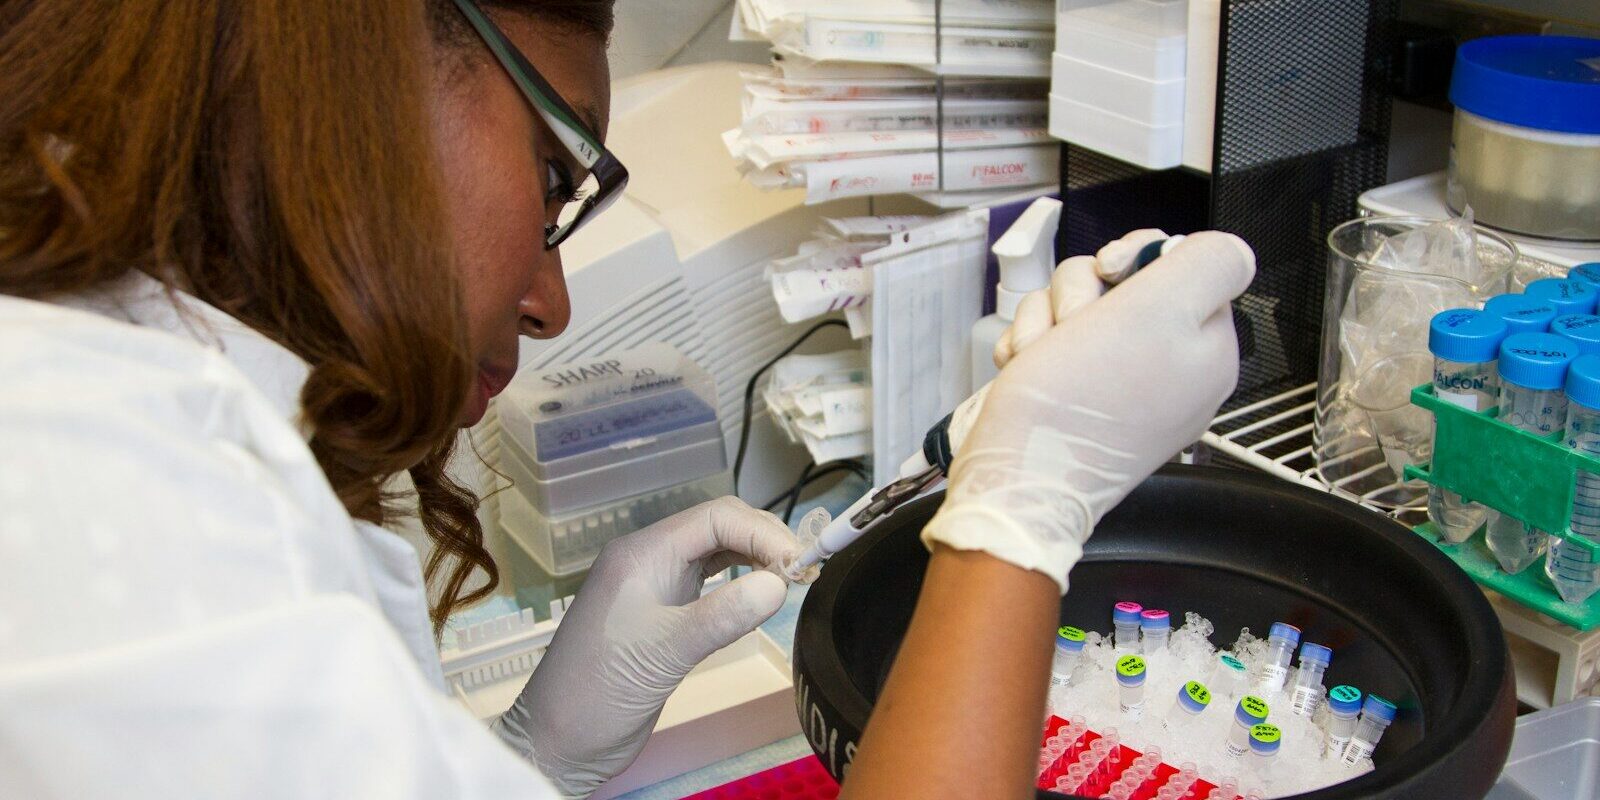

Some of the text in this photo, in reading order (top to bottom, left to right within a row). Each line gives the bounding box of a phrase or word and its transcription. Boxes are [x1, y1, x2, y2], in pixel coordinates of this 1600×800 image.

[984, 162, 1024, 176] FALCON
[542, 359, 623, 388] SHARP
[634, 367, 656, 380] 20
